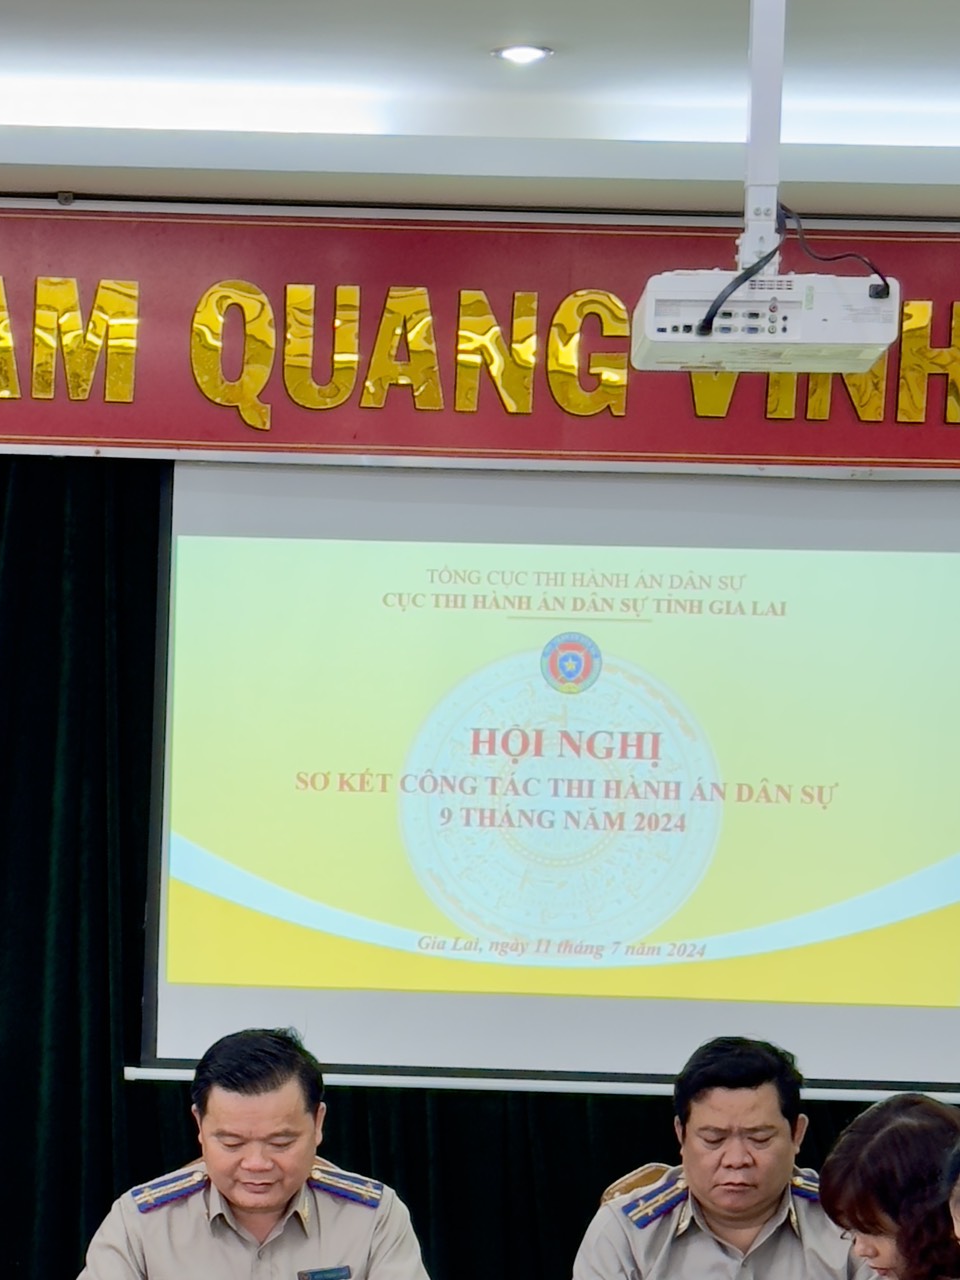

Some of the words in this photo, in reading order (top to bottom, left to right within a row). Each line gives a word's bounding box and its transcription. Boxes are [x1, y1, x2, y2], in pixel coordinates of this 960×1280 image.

[190, 279, 631, 431] QUANG
[487, 570, 528, 590] CỤC
[534, 571, 565, 587] THI
[572, 568, 629, 589] HÀNH
[634, 569, 663, 590] ÁN
[668, 570, 713, 590] DÂN
[718, 573, 747, 594] SỰ
[381, 592, 426, 612] CỤC
[431, 593, 467, 609] THI
[472, 590, 532, 611] HÀNH
[537, 591, 565, 611] ÁN
[571, 592, 615, 613] DÂN
[619, 596, 649, 618] SỰ
[652, 593, 704, 615] TỈNH
[708, 599, 747, 616] GIA
[751, 600, 788, 617] LAI
[470, 724, 546, 765] HỘI
[557, 729, 664, 768] NGHỊ
[295, 771, 331, 792] SƠ
[400, 768, 478, 796] CÔNG
[485, 772, 541, 797] TÁC
[548, 778, 596, 799] THI
[603, 775, 682, 800] HÀNH
[690, 776, 728, 802] ÁN
[735, 777, 794, 804] DÂN
[800, 782, 839, 811] SỰ
[440, 807, 453, 827] 9
[460, 804, 556, 830] THÁNG
[564, 806, 626, 832] NĂM
[634, 812, 687, 833] 2024
[417, 935, 447, 951] Gia
[451, 936, 484, 954] Lai,
[489, 939, 530, 957] ngày
[556, 939, 606, 960] tháng
[611, 941, 622, 956] 7
[624, 942, 662, 957] năm
[666, 942, 707, 958] 2024
